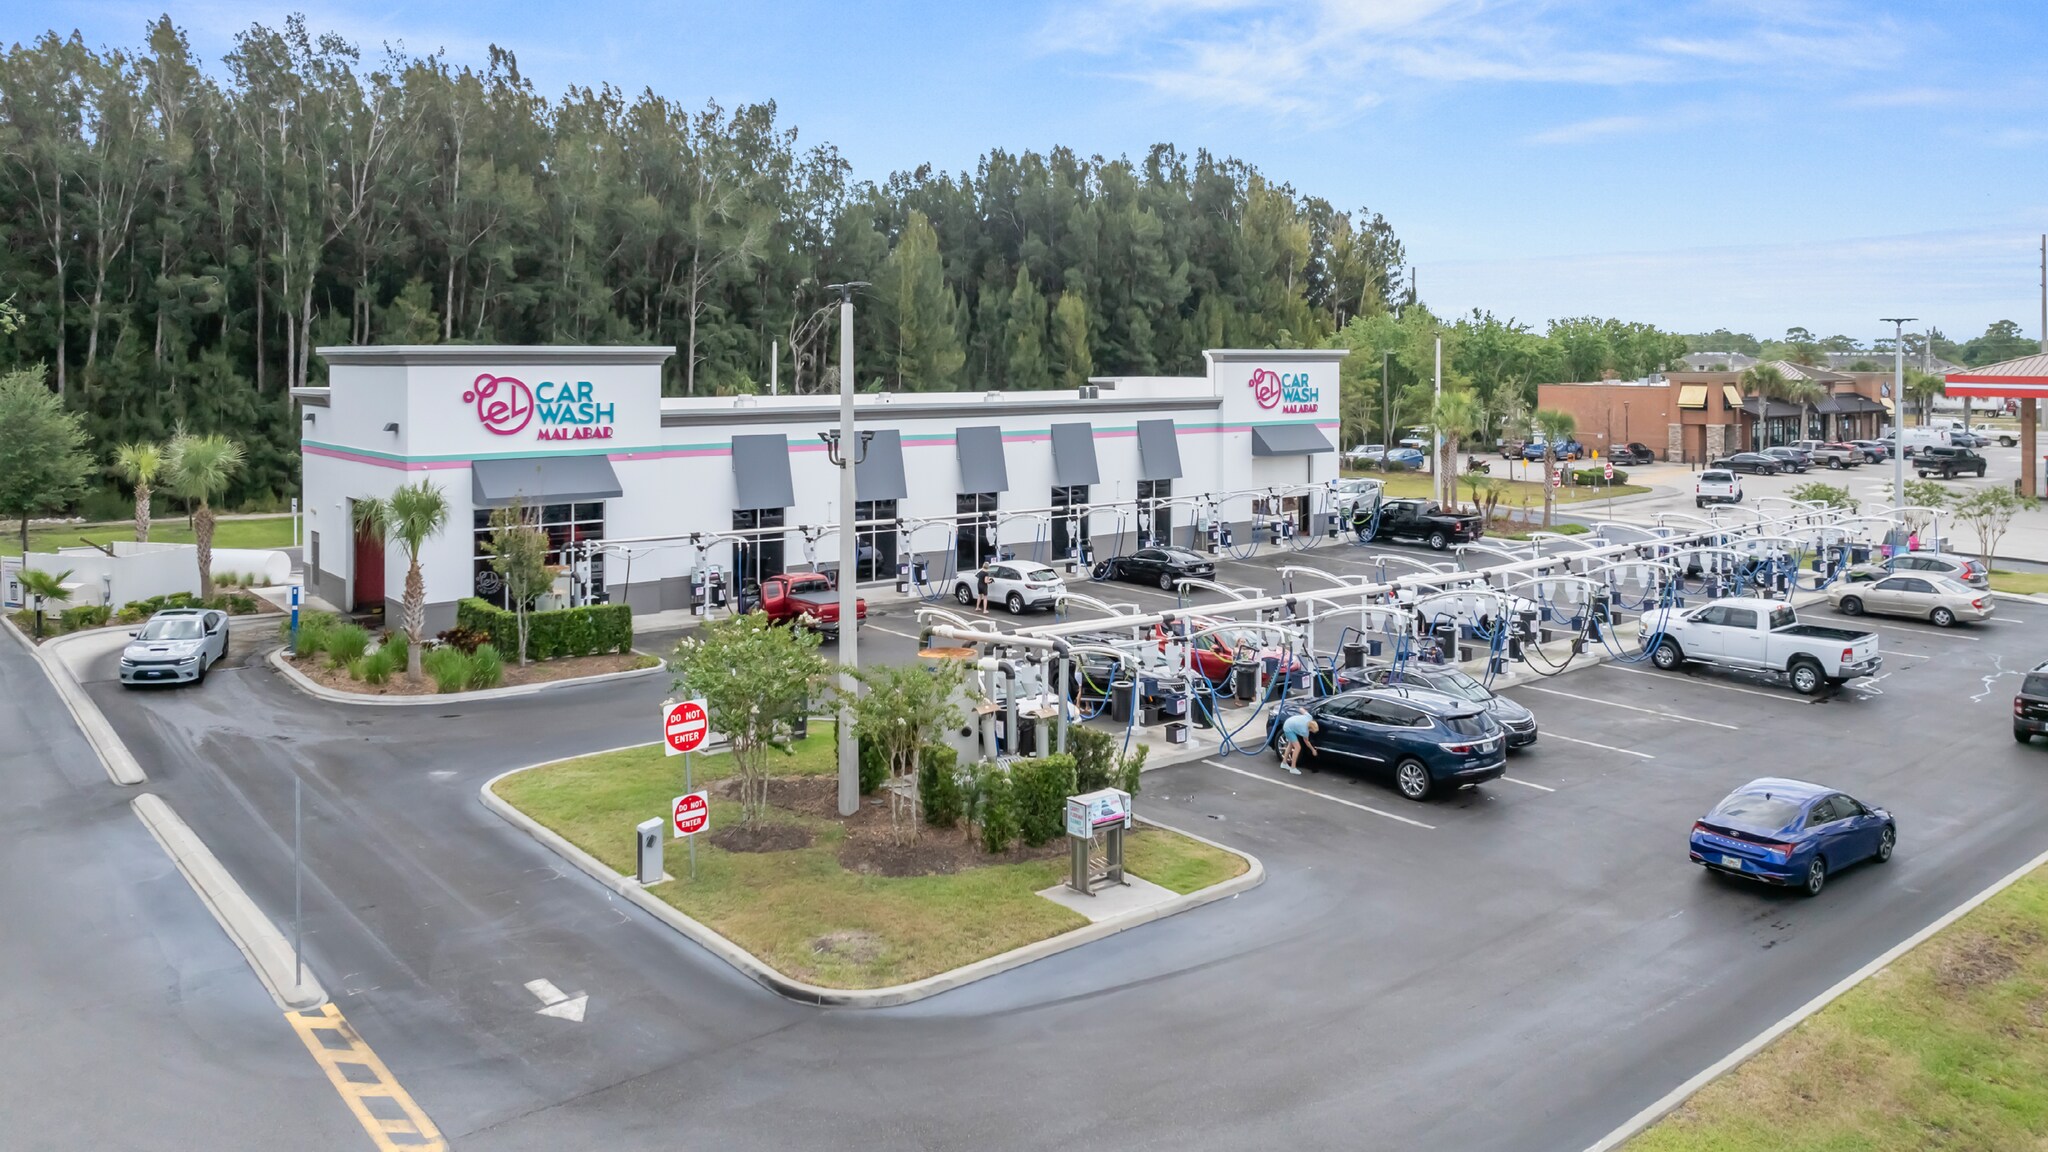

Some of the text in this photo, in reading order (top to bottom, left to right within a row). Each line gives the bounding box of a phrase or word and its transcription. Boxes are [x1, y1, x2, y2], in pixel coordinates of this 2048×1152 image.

[1281, 373, 1309, 388] CAR
[536, 381, 594, 403] CAR
[1281, 387, 1319, 403] WASH
[536, 402, 615, 425] WASH
[1282, 404, 1318, 414] MALABAR
[536, 426, 614, 441] MALABAR
[670, 709, 701, 724] DO NOT
[674, 731, 700, 744] ENTER
[678, 799, 703, 812] DO NOT
[681, 818, 702, 829] ENTER
